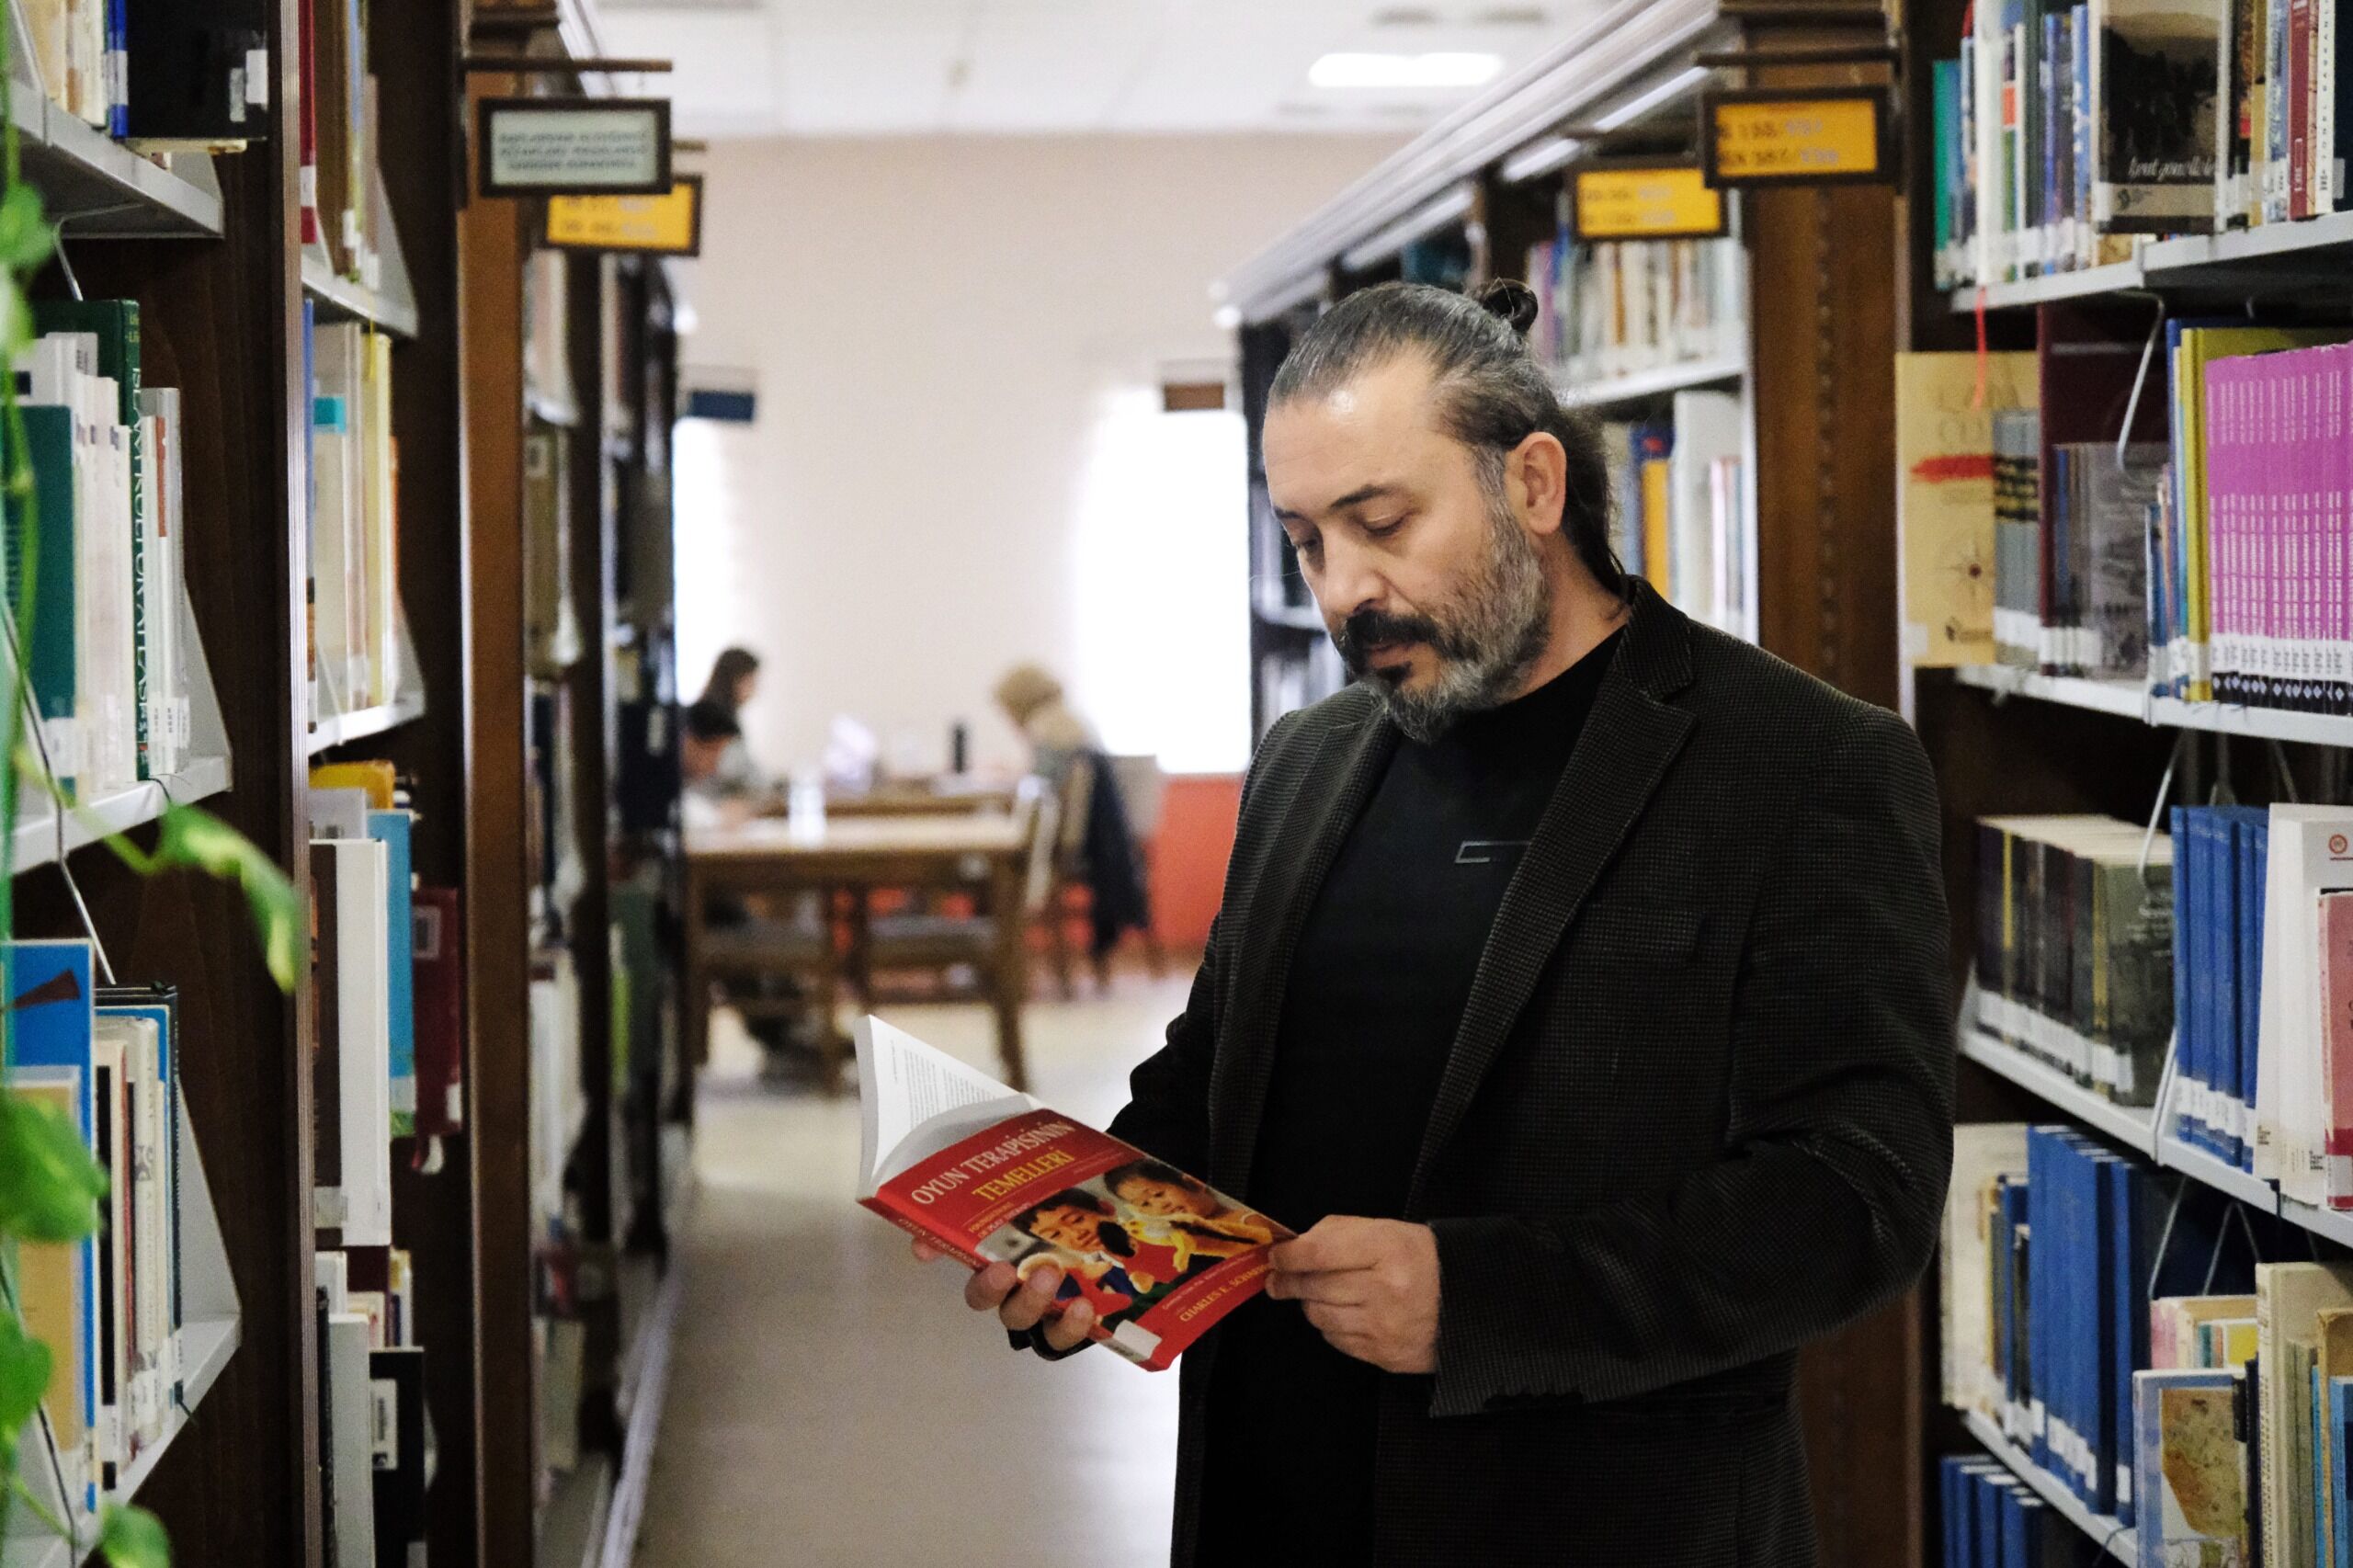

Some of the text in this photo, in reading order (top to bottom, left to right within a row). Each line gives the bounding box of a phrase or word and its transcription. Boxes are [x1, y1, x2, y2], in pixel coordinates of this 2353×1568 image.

[910, 1166, 971, 1204] OYUN
[960, 1119, 1077, 1175] TERAPİSİNİN
[971, 1145, 1076, 1201] TEMELLERİ
[1178, 1290, 1222, 1322] CHARLES
